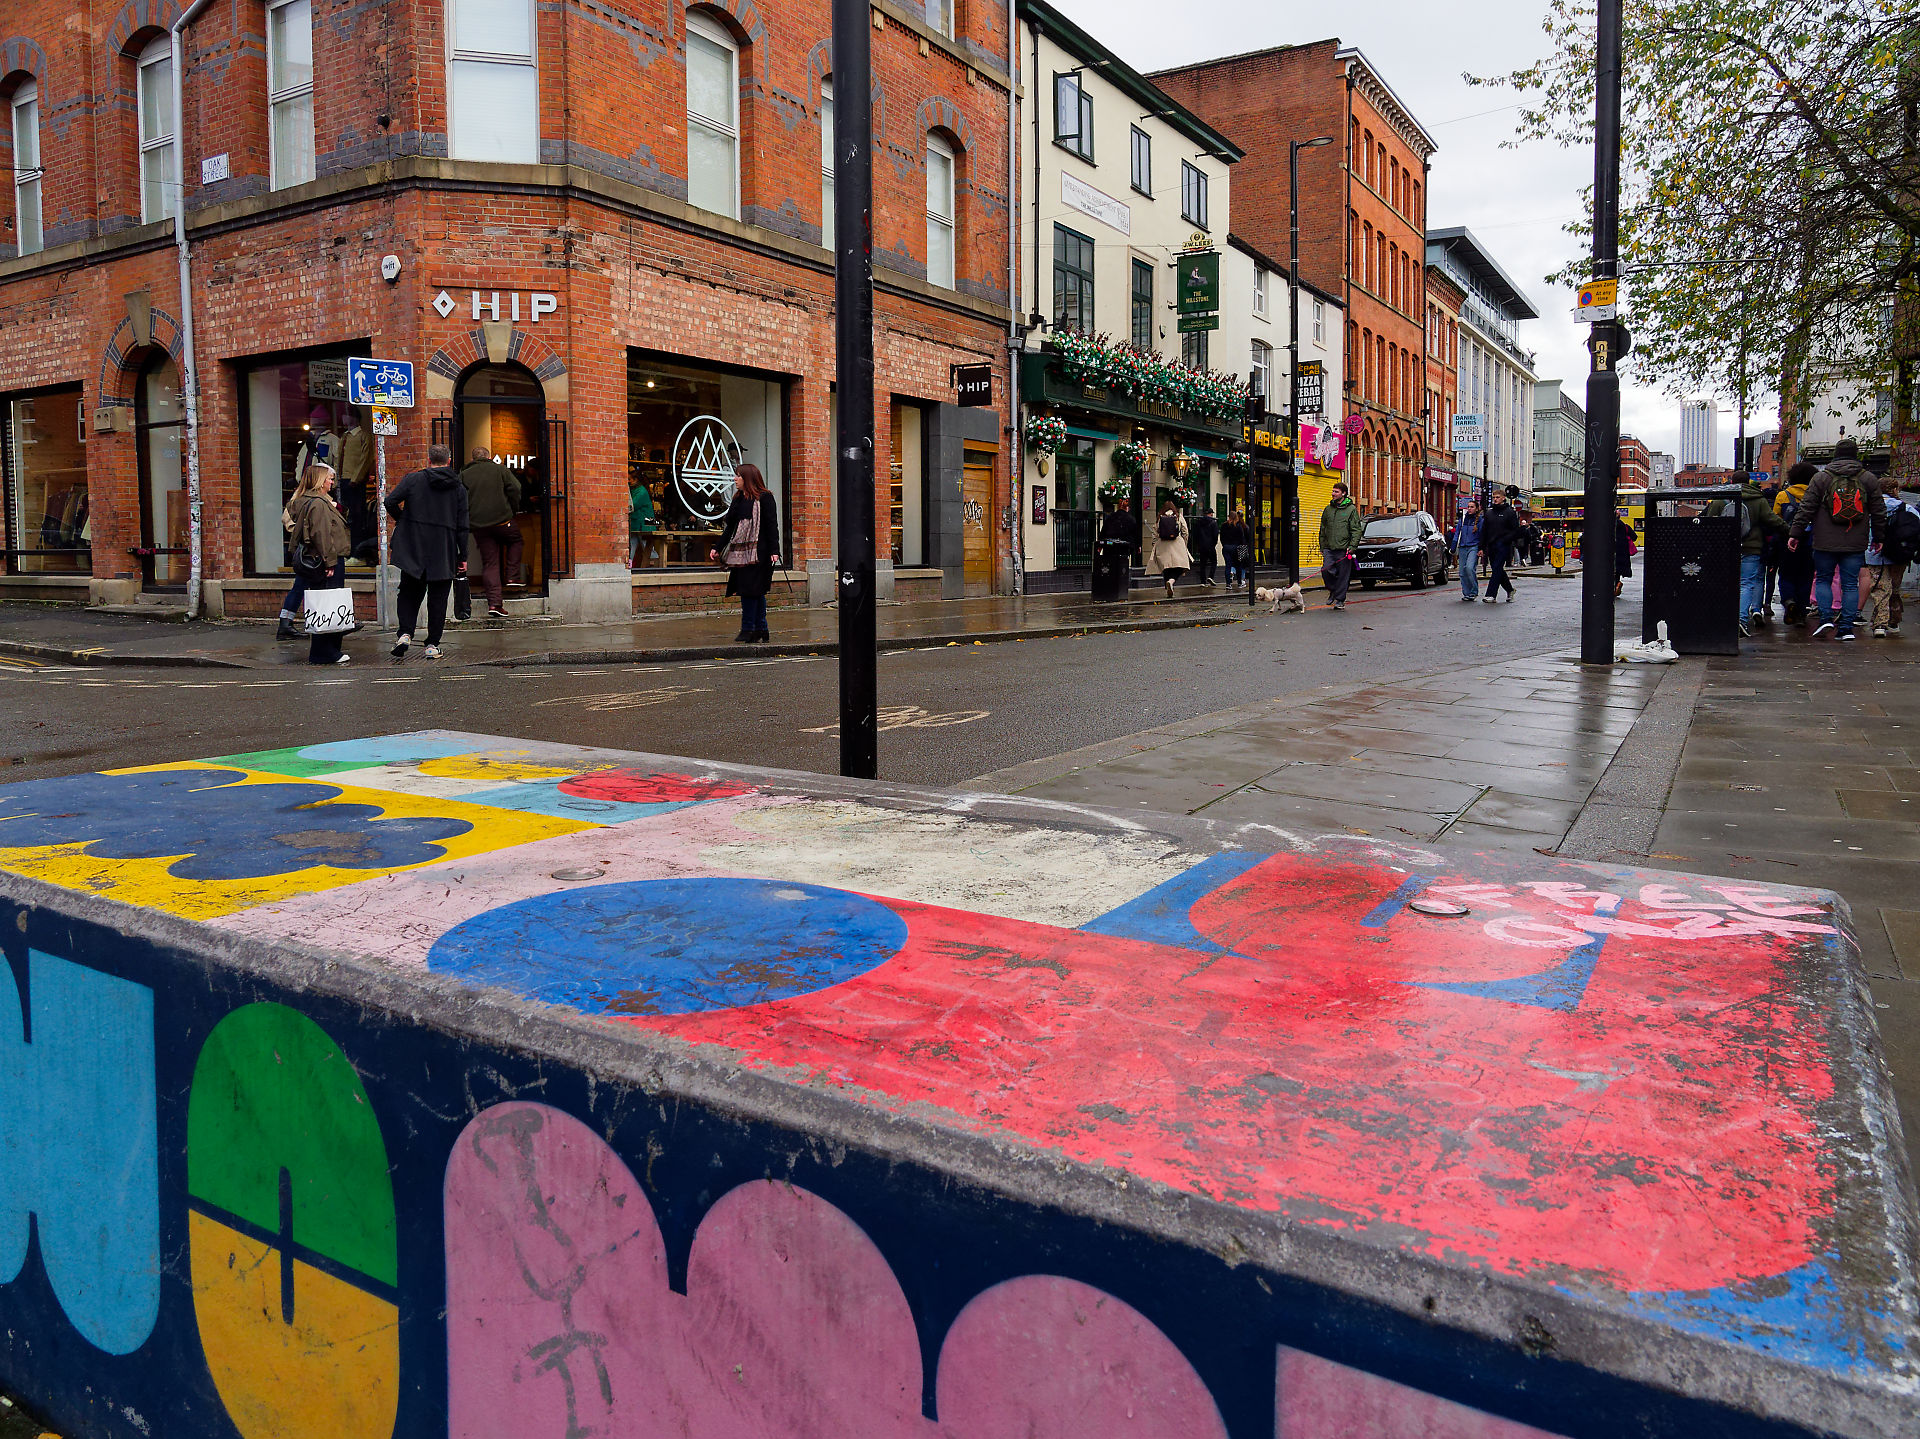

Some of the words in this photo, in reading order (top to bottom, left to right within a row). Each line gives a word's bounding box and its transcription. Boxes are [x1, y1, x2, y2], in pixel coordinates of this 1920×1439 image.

[208, 158, 221, 169] OAK
[203, 166, 227, 182] STREET
[472, 291, 558, 322] HIP
[1297, 364, 1320, 372] EBAB
[966, 381, 989, 393] HIP
[1298, 375, 1320, 387] IZZA
[1298, 386, 1321, 398] EBAB
[1298, 396, 1321, 407] URGER
[1427, 881, 1828, 916] FREE
